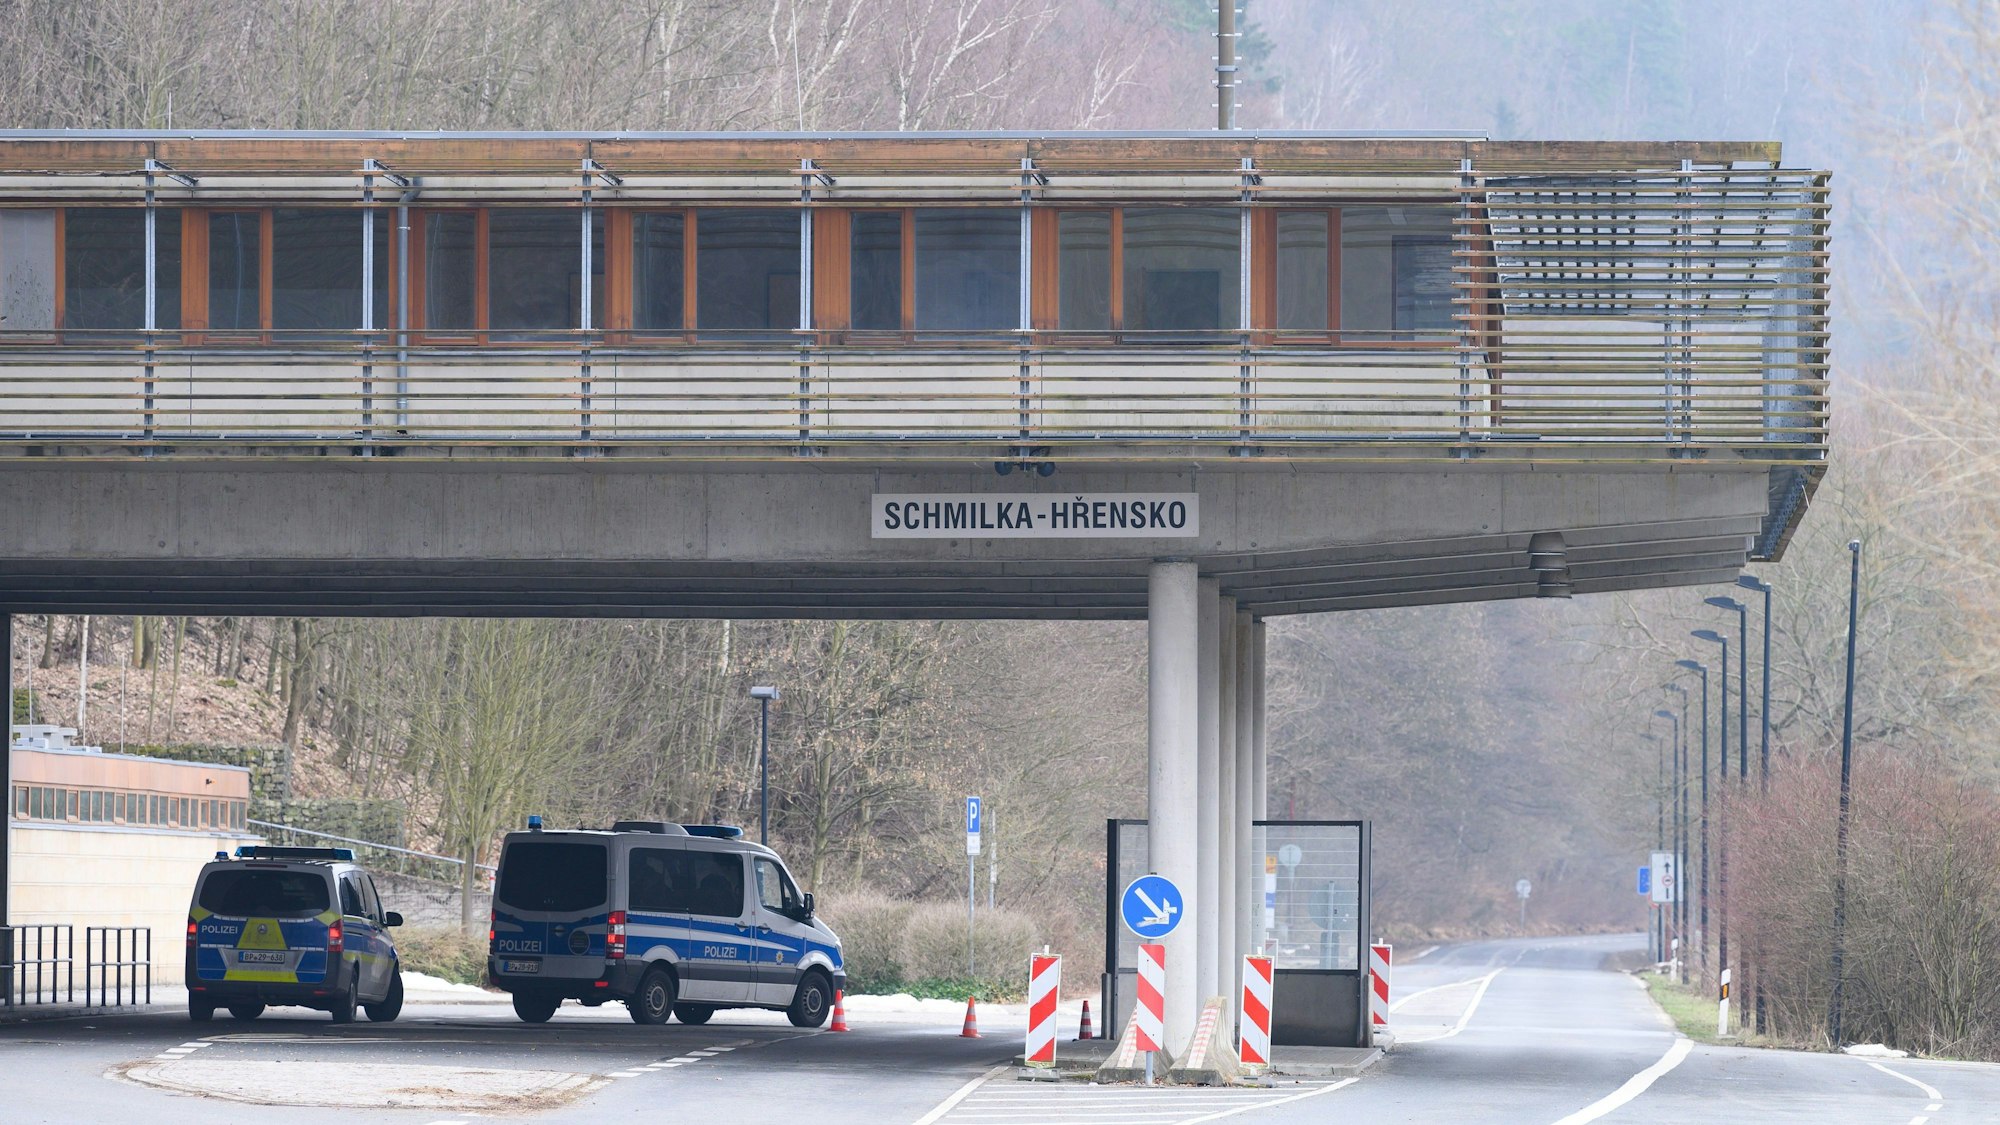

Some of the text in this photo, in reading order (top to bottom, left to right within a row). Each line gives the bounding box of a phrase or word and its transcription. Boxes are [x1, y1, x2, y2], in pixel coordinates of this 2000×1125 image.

[884, 496, 1186, 530] SCHMILKA-HŘENSKO
[970, 801, 977, 829] P
[201, 925, 238, 934] POLIZEI
[499, 939, 542, 953] POLIZEI
[704, 945, 737, 958] POLIZEI
